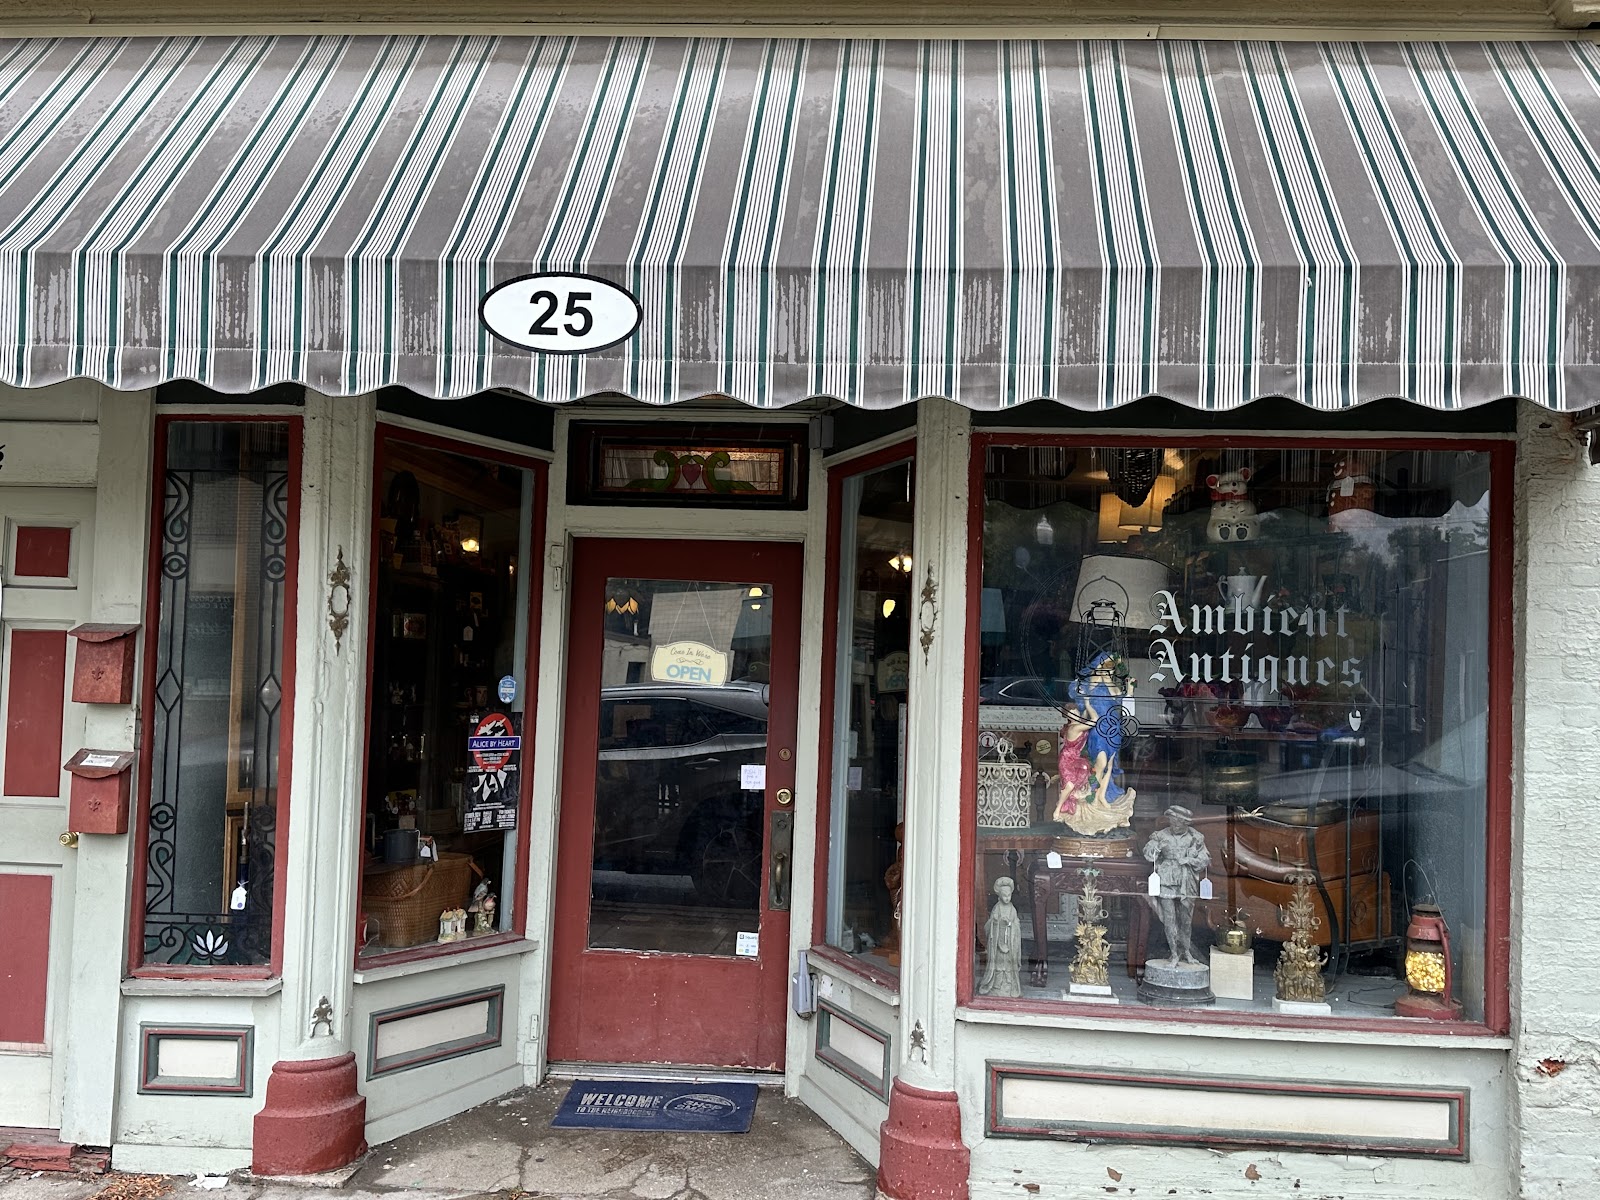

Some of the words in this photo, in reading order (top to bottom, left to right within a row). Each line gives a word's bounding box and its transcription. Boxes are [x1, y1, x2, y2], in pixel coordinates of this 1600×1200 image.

[528, 290, 594, 337] 25
[1149, 589, 1350, 638] Ambient
[670, 647, 686, 656] Come
[685, 648, 694, 656] In
[666, 664, 712, 682] OPEN
[1148, 638, 1364, 694] Antiques
[472, 740, 489, 748] ALICE
[489, 740, 497, 748] BY
[497, 739, 516, 747] HEART
[580, 1092, 663, 1109] WELCOME
